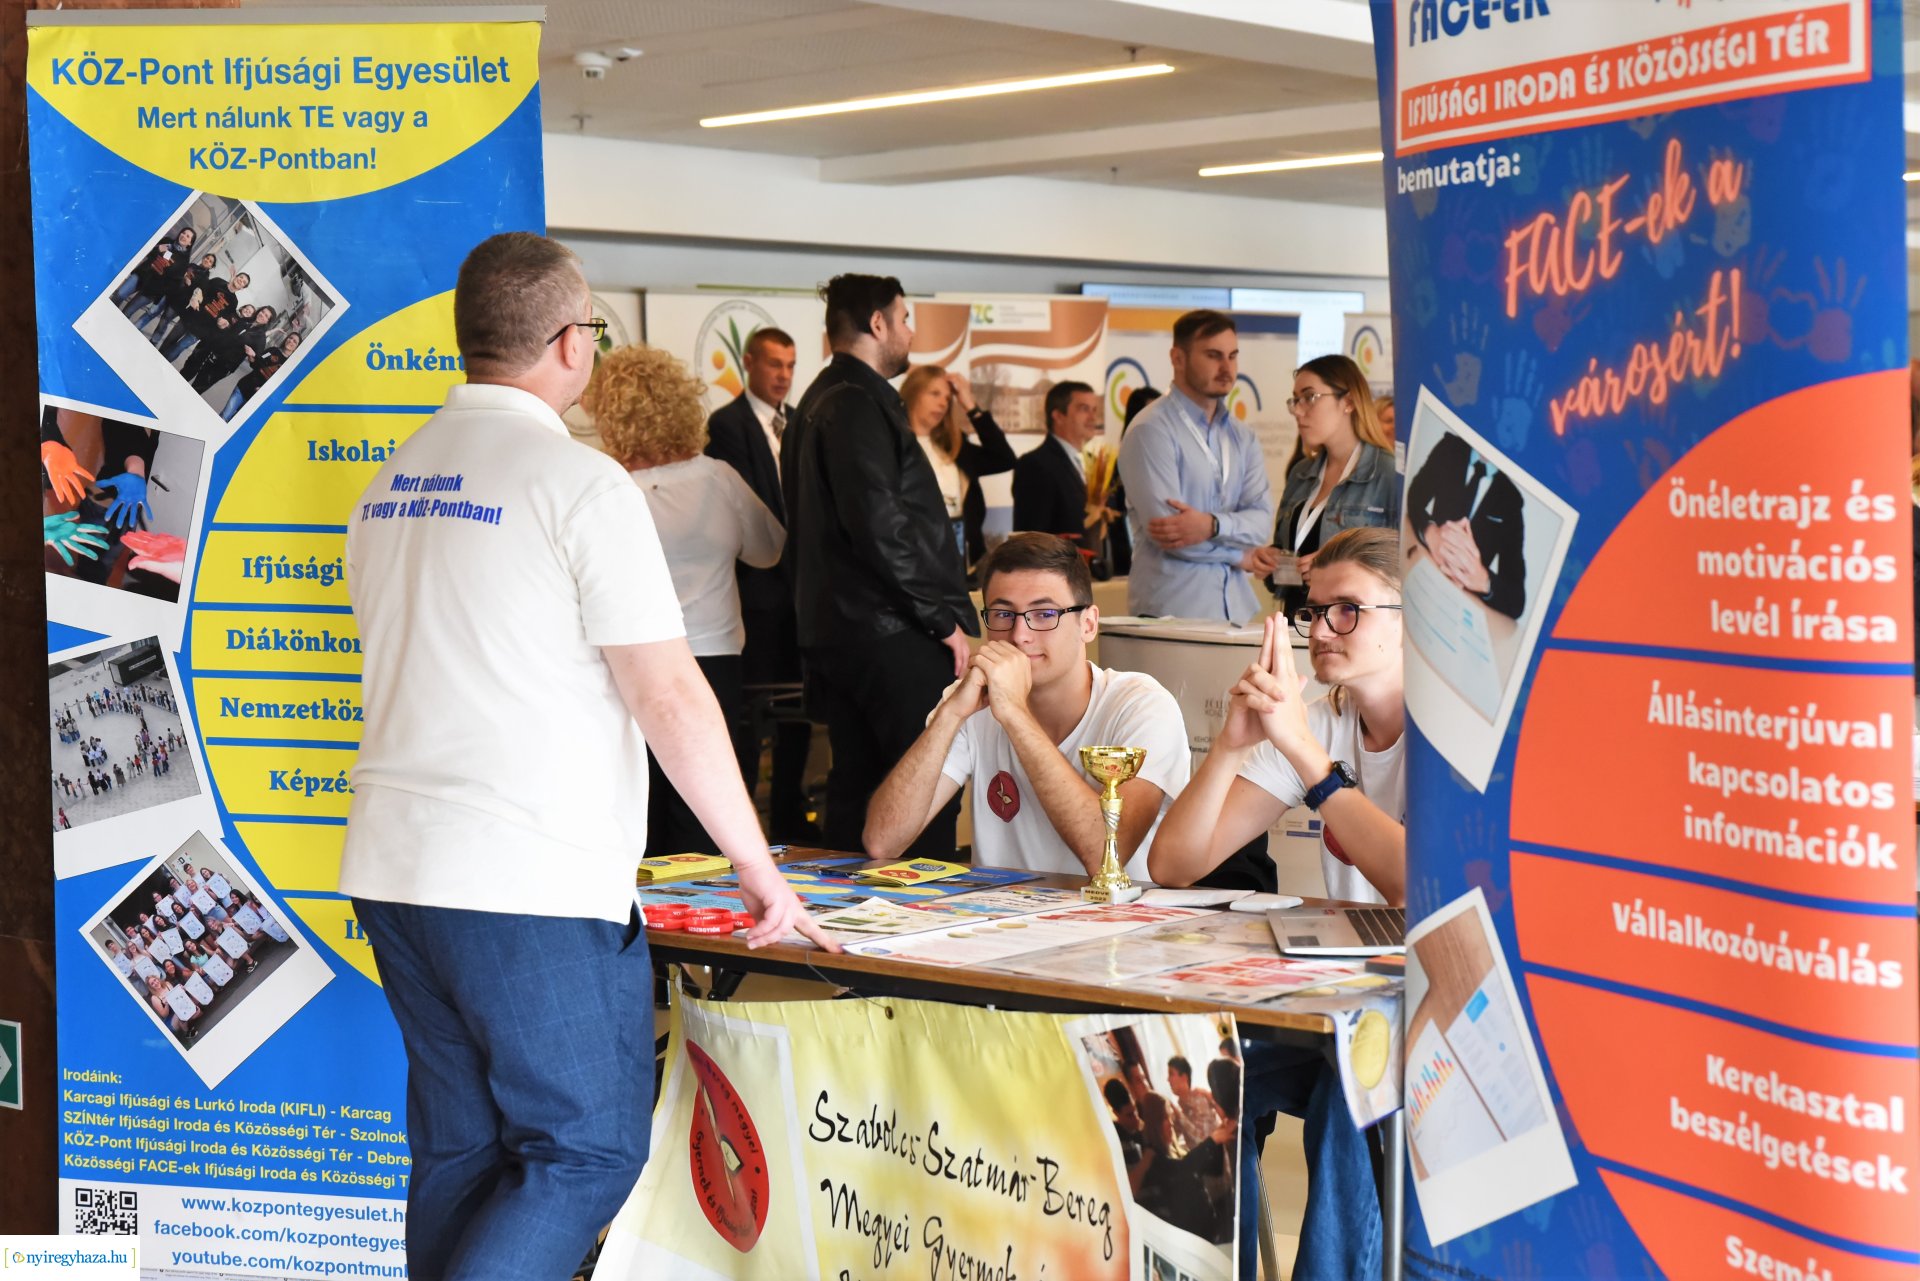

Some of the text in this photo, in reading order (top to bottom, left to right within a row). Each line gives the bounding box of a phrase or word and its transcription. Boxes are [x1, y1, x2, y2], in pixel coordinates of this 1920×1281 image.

[51, 50, 511, 91] KÖZ-Pont Ifjúsági Egyesület
[1409, 14, 1831, 128] IFJÚSÁGI IRODA ÉS KÖZÖSSÉGI TÉR
[137, 104, 429, 134] Mert nálunk TE vagy a
[189, 143, 378, 171] KÖZ-Pontban!
[1397, 147, 1521, 194] bemutatja:
[1503, 137, 1744, 320] FACE-ek a
[1549, 267, 1743, 437] városért!
[389, 473, 464, 493] Mert nálunk
[1668, 476, 1897, 529] Önéletrajz és
[371, 500, 398, 519] vagy
[398, 500, 408, 518] a
[406, 496, 504, 526] KÖZ-Pontban!
[242, 556, 344, 588] Ifjúsági
[1697, 538, 1898, 583] motivációs
[1710, 596, 1898, 643] levél írása
[220, 695, 364, 724] Nemzetköz
[1647, 679, 1894, 750] Állásinterjúval
[1687, 751, 1896, 811] kapcsolatos
[1683, 804, 1899, 871] információk
[1612, 898, 1904, 989] Vállalkozóváválás
[63, 1067, 122, 1084] Irodáink:
[1705, 1053, 1905, 1134] Kerekasztal
[62, 1088, 116, 1107] Karcagi
[119, 1092, 171, 1112] Ifjúsági
[173, 1096, 191, 1111] és
[194, 1096, 236, 1113] Lurkó
[239, 1099, 276, 1115] Iroda
[280, 1101, 327, 1120] (KIFLI)
[340, 1105, 393, 1124] Karcag
[63, 1109, 116, 1127] SZÍNtér
[119, 1114, 170, 1134] Ifjúsági
[173, 1117, 211, 1133] Iroda
[213, 1120, 231, 1134] és
[234, 1120, 309, 1142] Közösségi
[312, 1124, 337, 1140] Tér
[350, 1127, 408, 1144] Szolnok
[63, 1130, 133, 1150] KÖZ-Pont
[135, 1136, 188, 1156] Ifjúsági
[190, 1139, 228, 1155] Iroda
[230, 1143, 249, 1156] és
[251, 1143, 326, 1164] Közösségi
[329, 1147, 354, 1163] Tér
[1670, 1096, 1909, 1195] beszélgetések
[63, 1153, 136, 1174] Közösségi
[139, 1158, 201, 1175] FACE-ek
[204, 1162, 257, 1182] Ifjúsági
[259, 1165, 298, 1181] Iroda
[300, 1168, 318, 1183] és
[320, 1169, 396, 1190] Közösségi
[180, 1194, 407, 1223] www.kozpontegyesulet.h
[820, 1178, 910, 1270] Megyei
